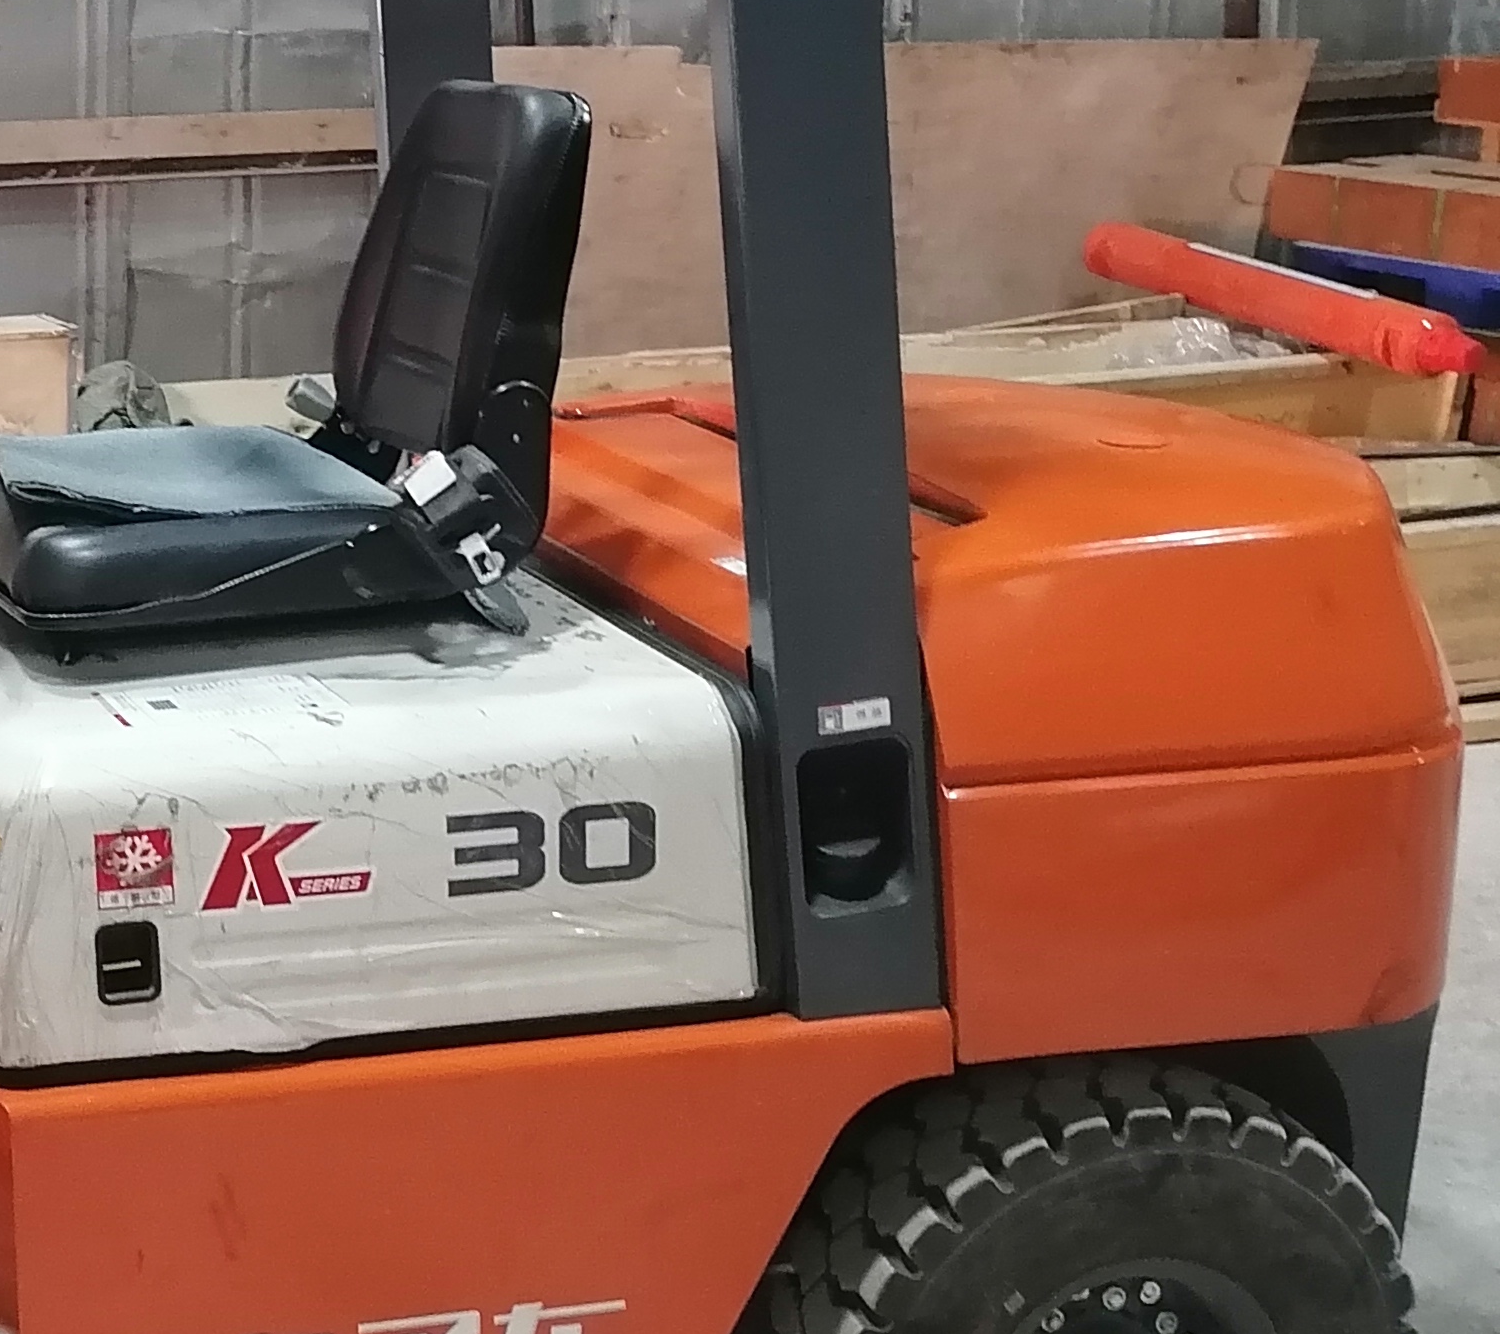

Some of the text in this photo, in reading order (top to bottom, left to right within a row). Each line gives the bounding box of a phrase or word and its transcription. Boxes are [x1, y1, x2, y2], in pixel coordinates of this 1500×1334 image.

[202, 820, 363, 911] K SERIES
[446, 801, 657, 898] 30
